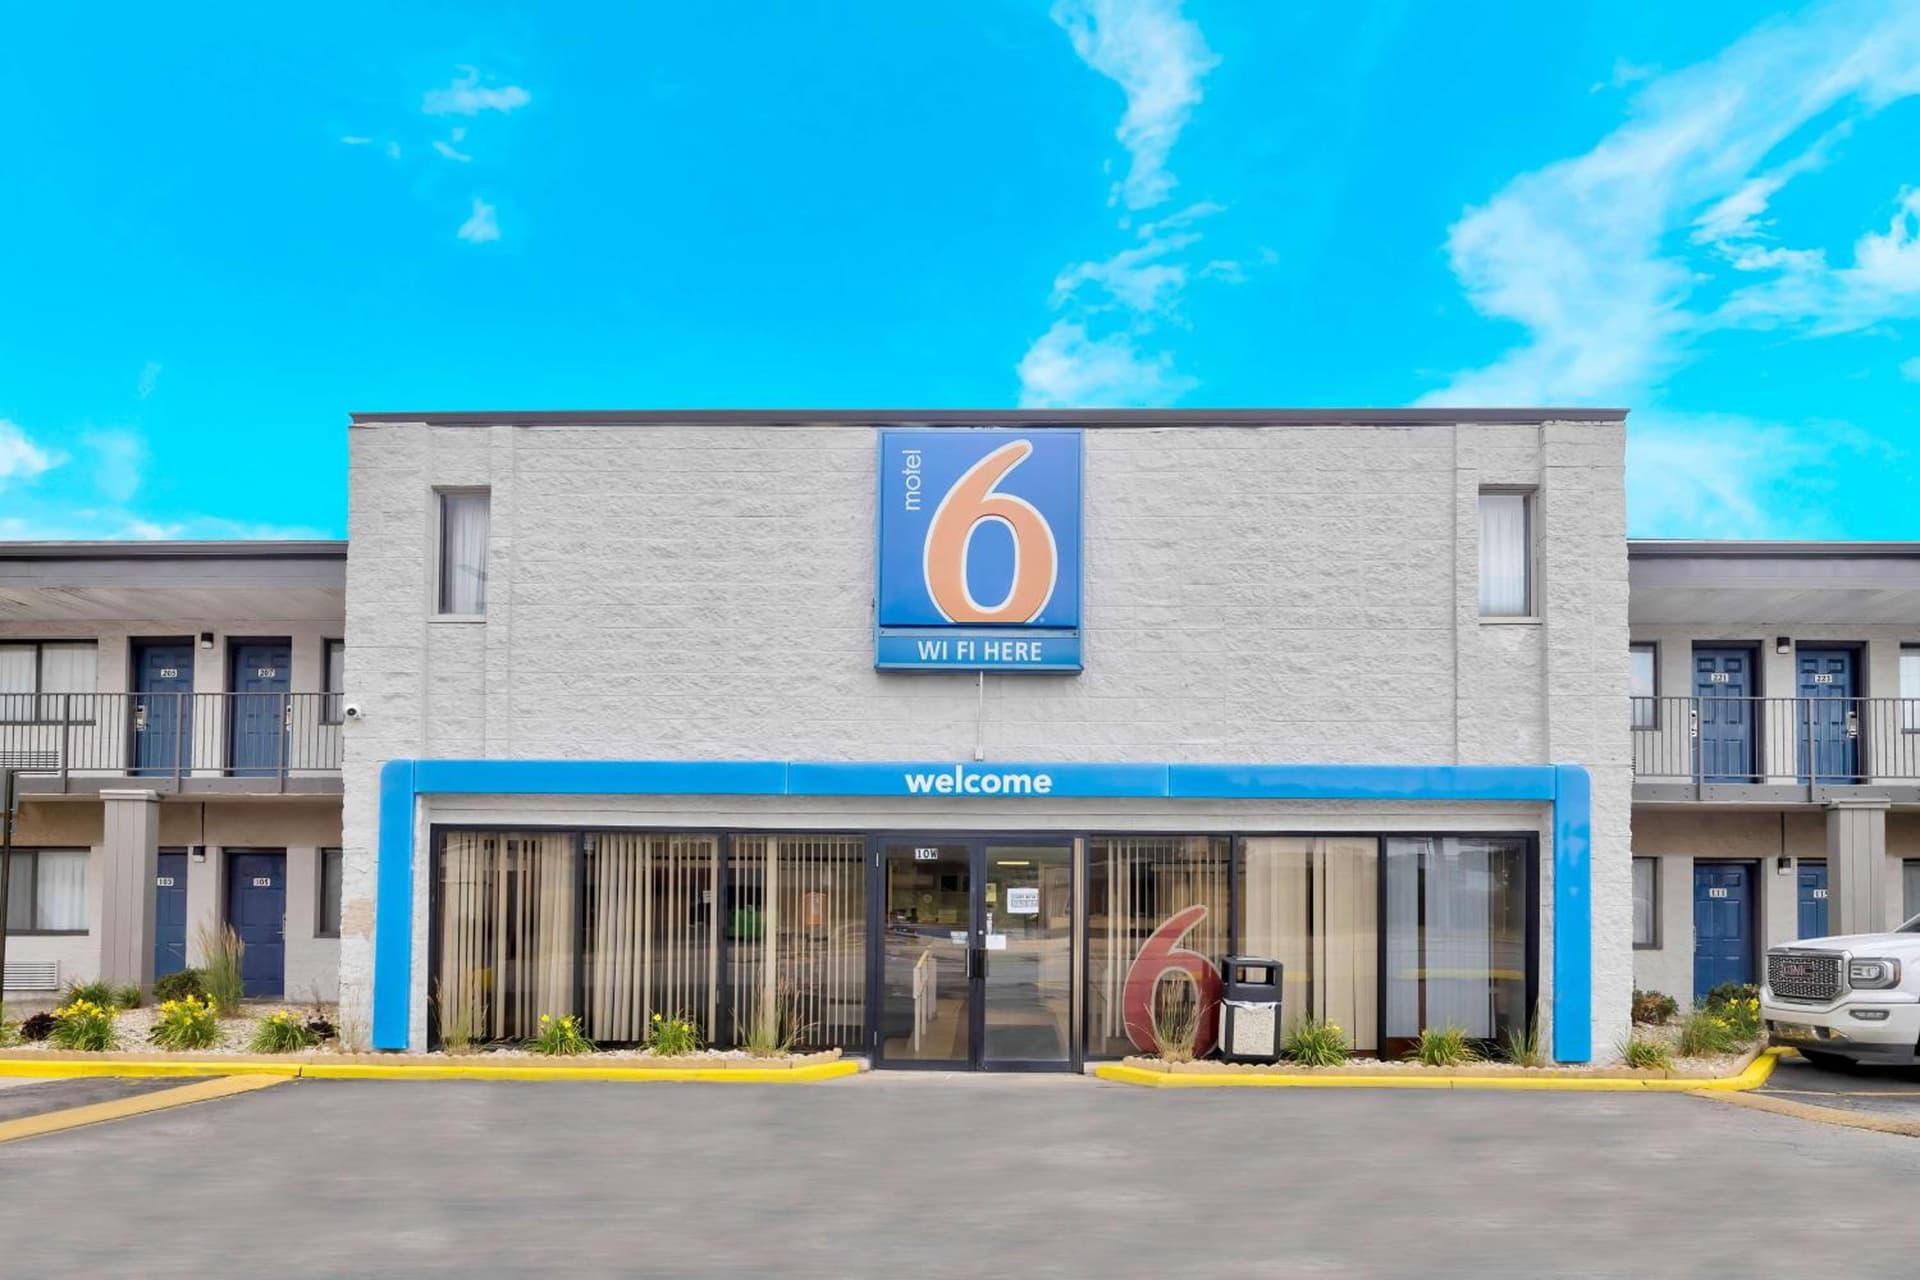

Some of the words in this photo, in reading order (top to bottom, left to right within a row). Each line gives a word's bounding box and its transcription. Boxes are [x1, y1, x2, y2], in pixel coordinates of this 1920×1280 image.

[902, 449, 921, 511] motel
[923, 439, 1058, 623] 6
[917, 641, 947, 661] WI
[957, 641, 975, 661] FI
[984, 641, 1043, 662] HERE
[904, 764, 1053, 793] welcome
[1122, 904, 1222, 1058] 6
